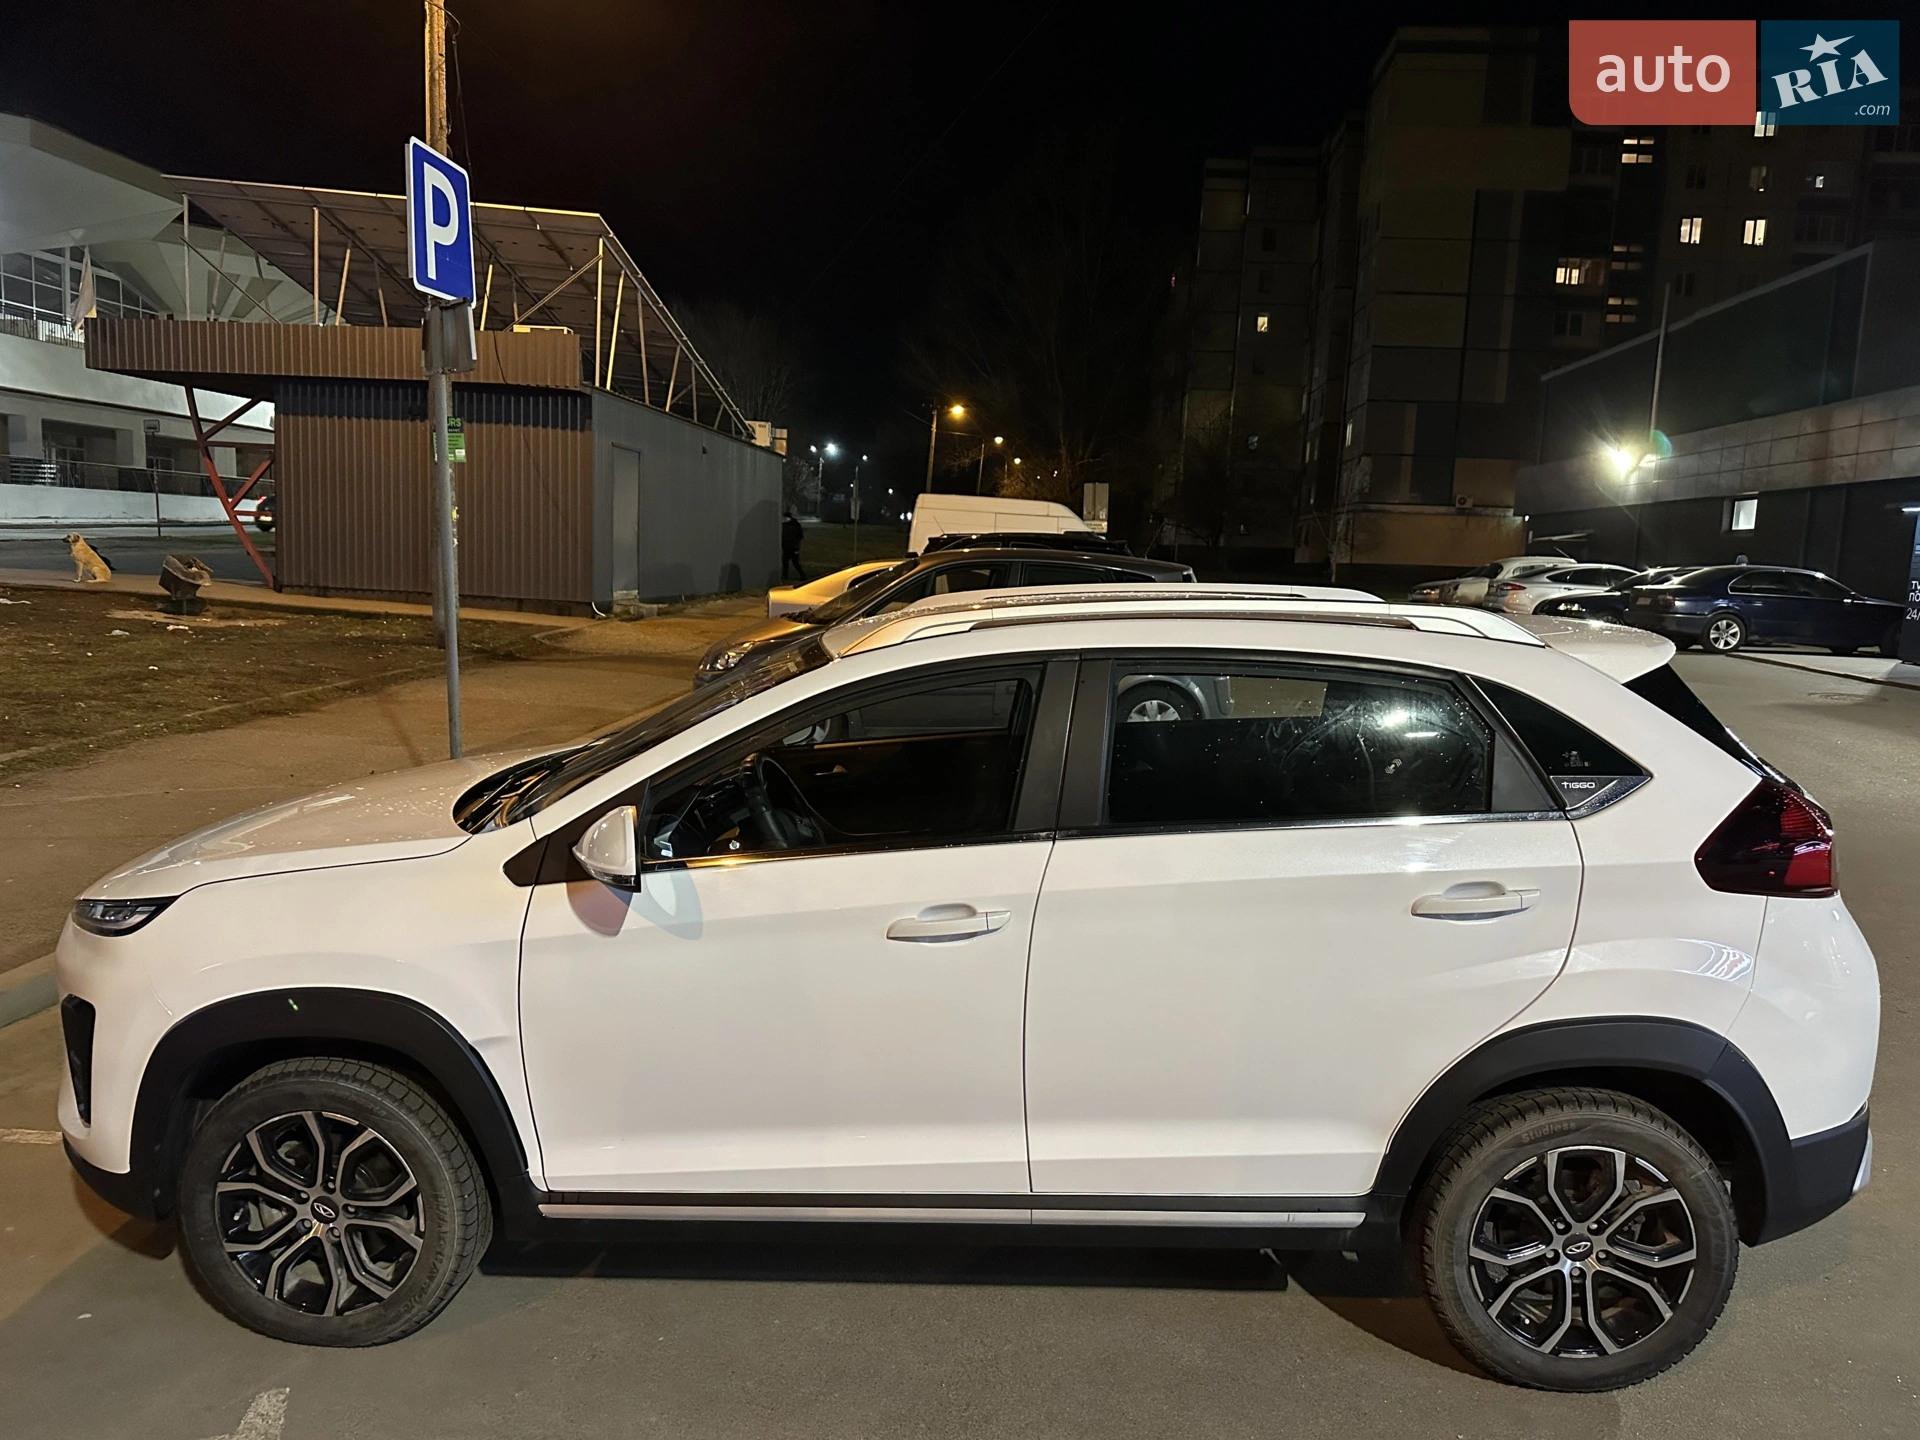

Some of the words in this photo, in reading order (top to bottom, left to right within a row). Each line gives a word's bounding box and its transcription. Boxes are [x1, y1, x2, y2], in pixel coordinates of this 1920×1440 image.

[423, 161, 459, 281] P
[1561, 780, 1596, 789] TIGGO
[1521, 1122, 1577, 1143] Studless
